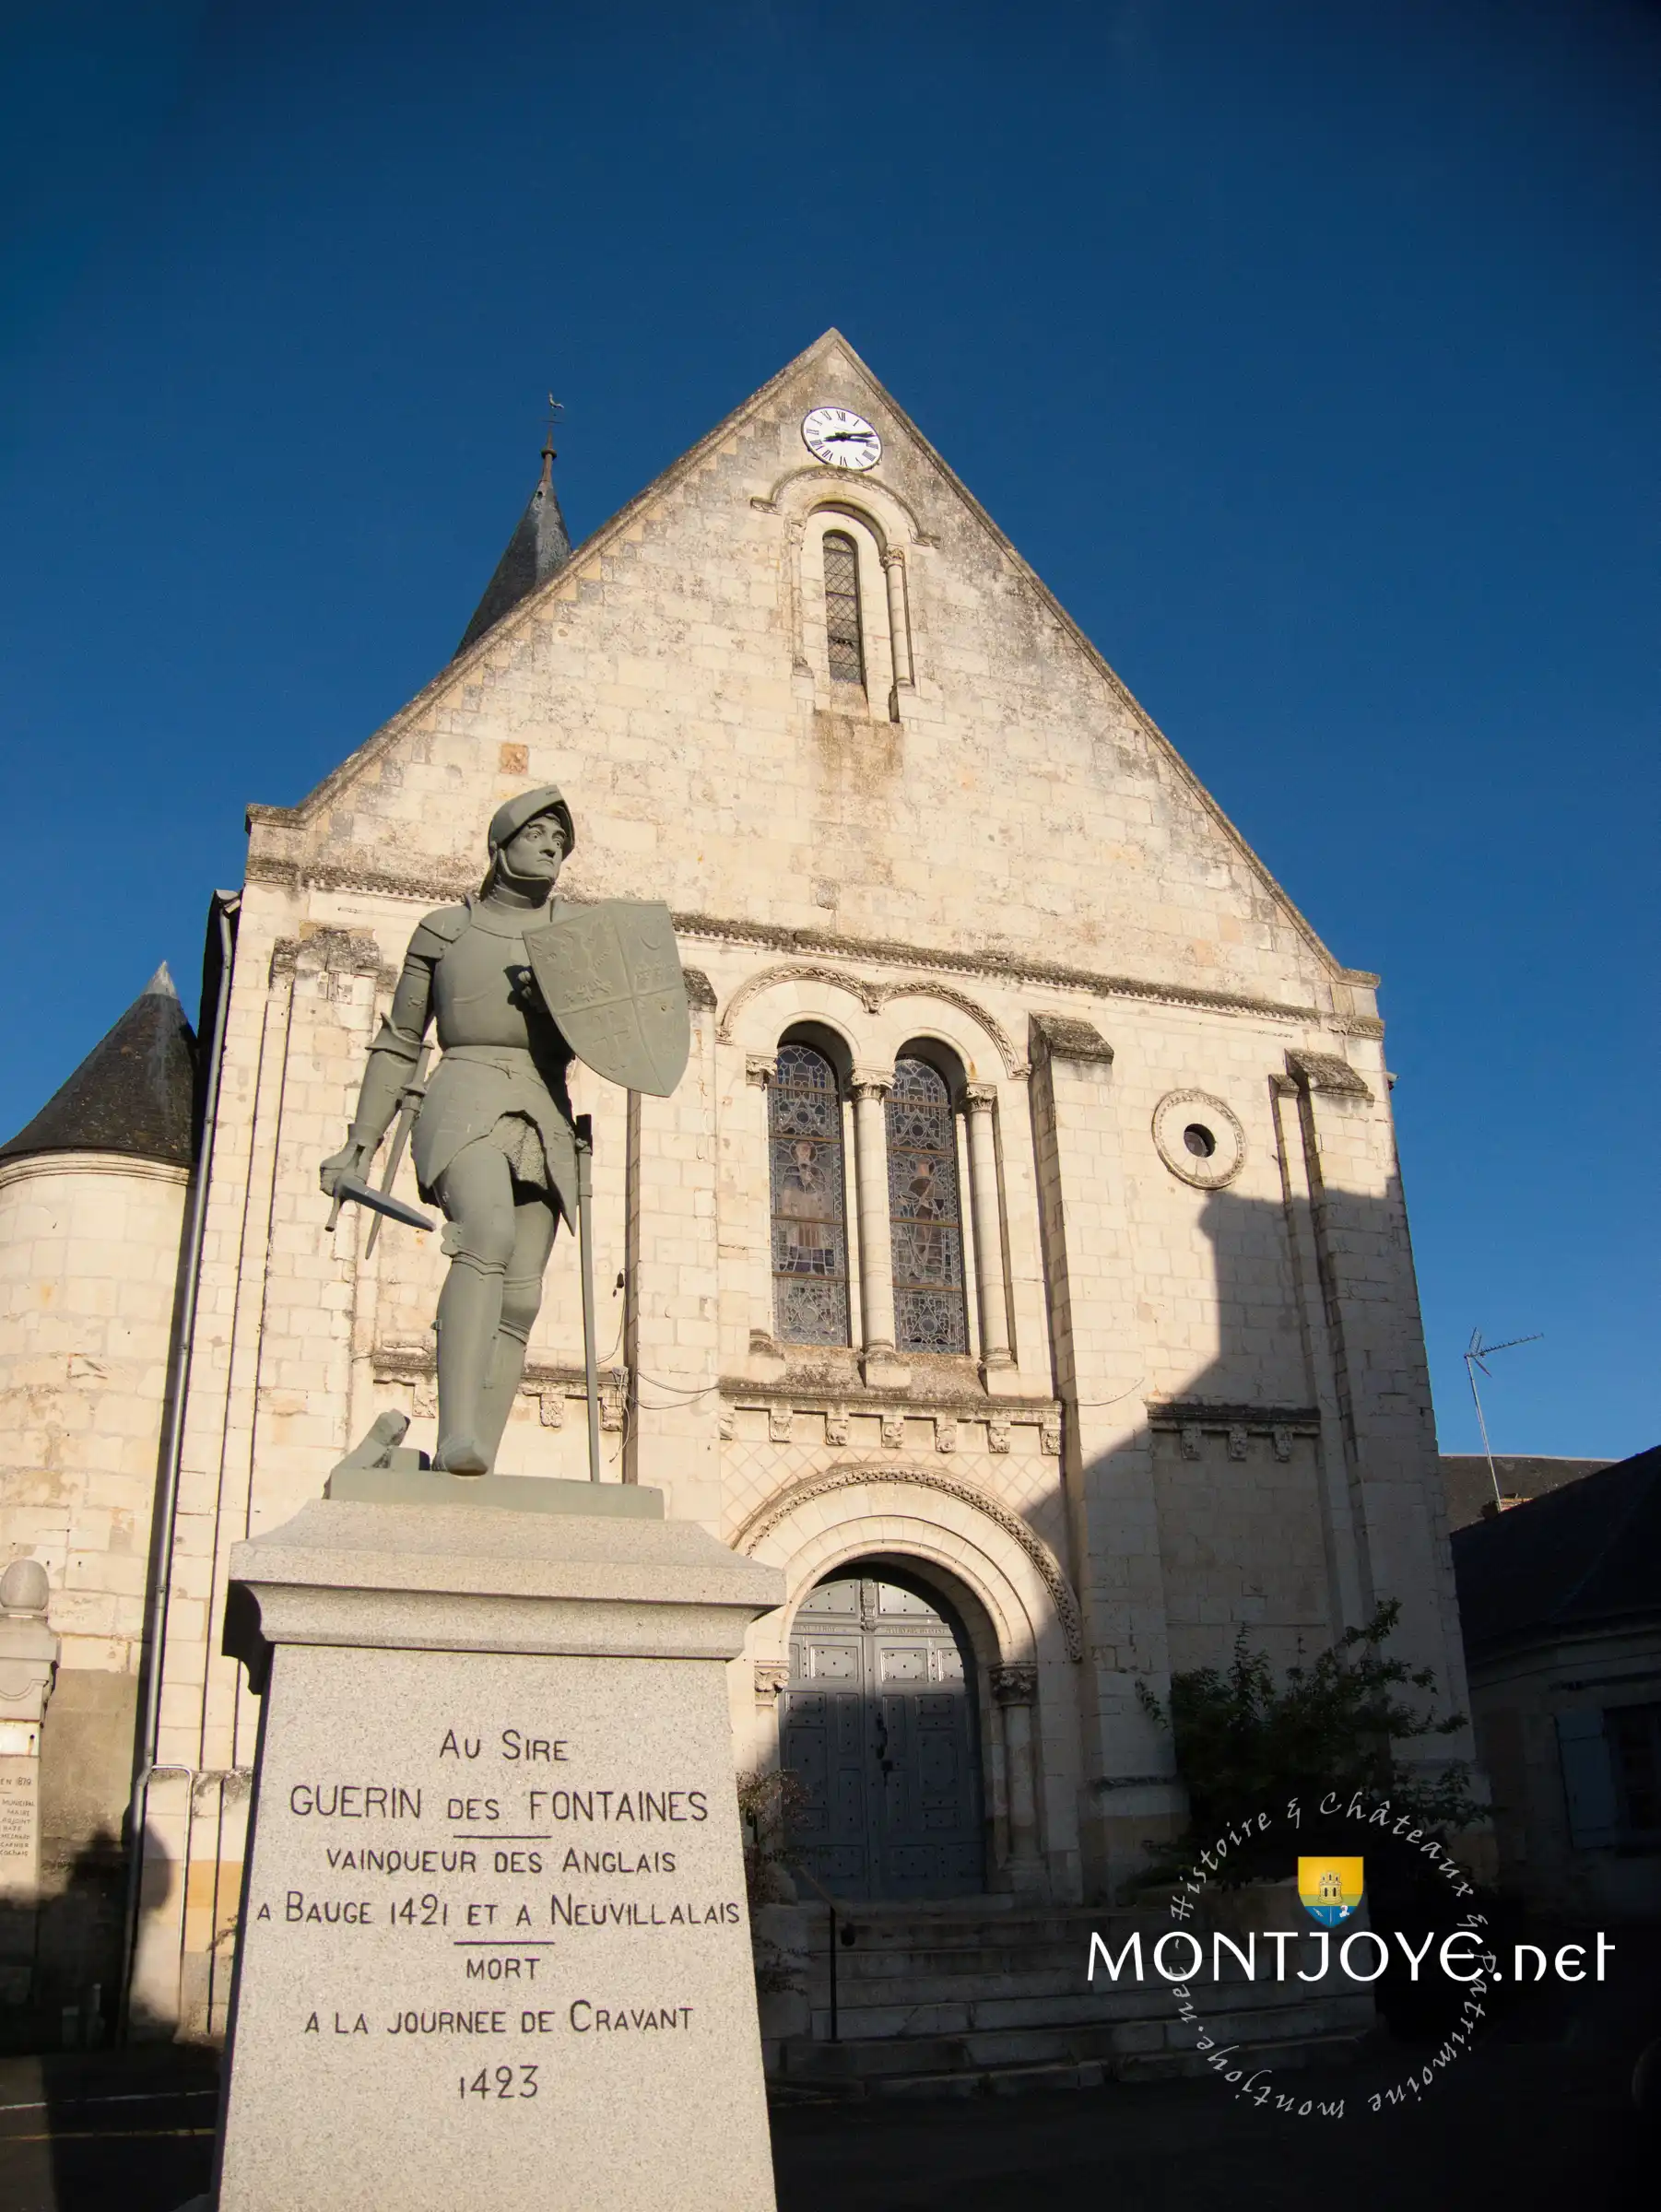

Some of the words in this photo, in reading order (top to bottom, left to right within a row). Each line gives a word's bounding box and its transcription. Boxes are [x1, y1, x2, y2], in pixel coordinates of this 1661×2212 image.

[290, 1784, 422, 1819] GUERIN
[447, 1798, 500, 1821] DES
[530, 1791, 709, 1823] FONTAINES
[326, 1849, 477, 1876] VAINQUEUR
[495, 1852, 543, 1875] DES
[562, 1848, 677, 1875] ANGLAIS
[257, 1903, 271, 1921] A
[391, 1893, 448, 1926] 1421
[467, 1904, 499, 1927] ET
[516, 1904, 532, 1927] A
[466, 1959, 541, 1981] MORT
[304, 2012, 320, 2034] A
[335, 2012, 369, 2035] LA
[387, 2011, 506, 2035] JOURNEE
[522, 2011, 555, 2034] DE
[570, 1999, 694, 2033] CRAVANT
[459, 2065, 539, 2100] 1423
